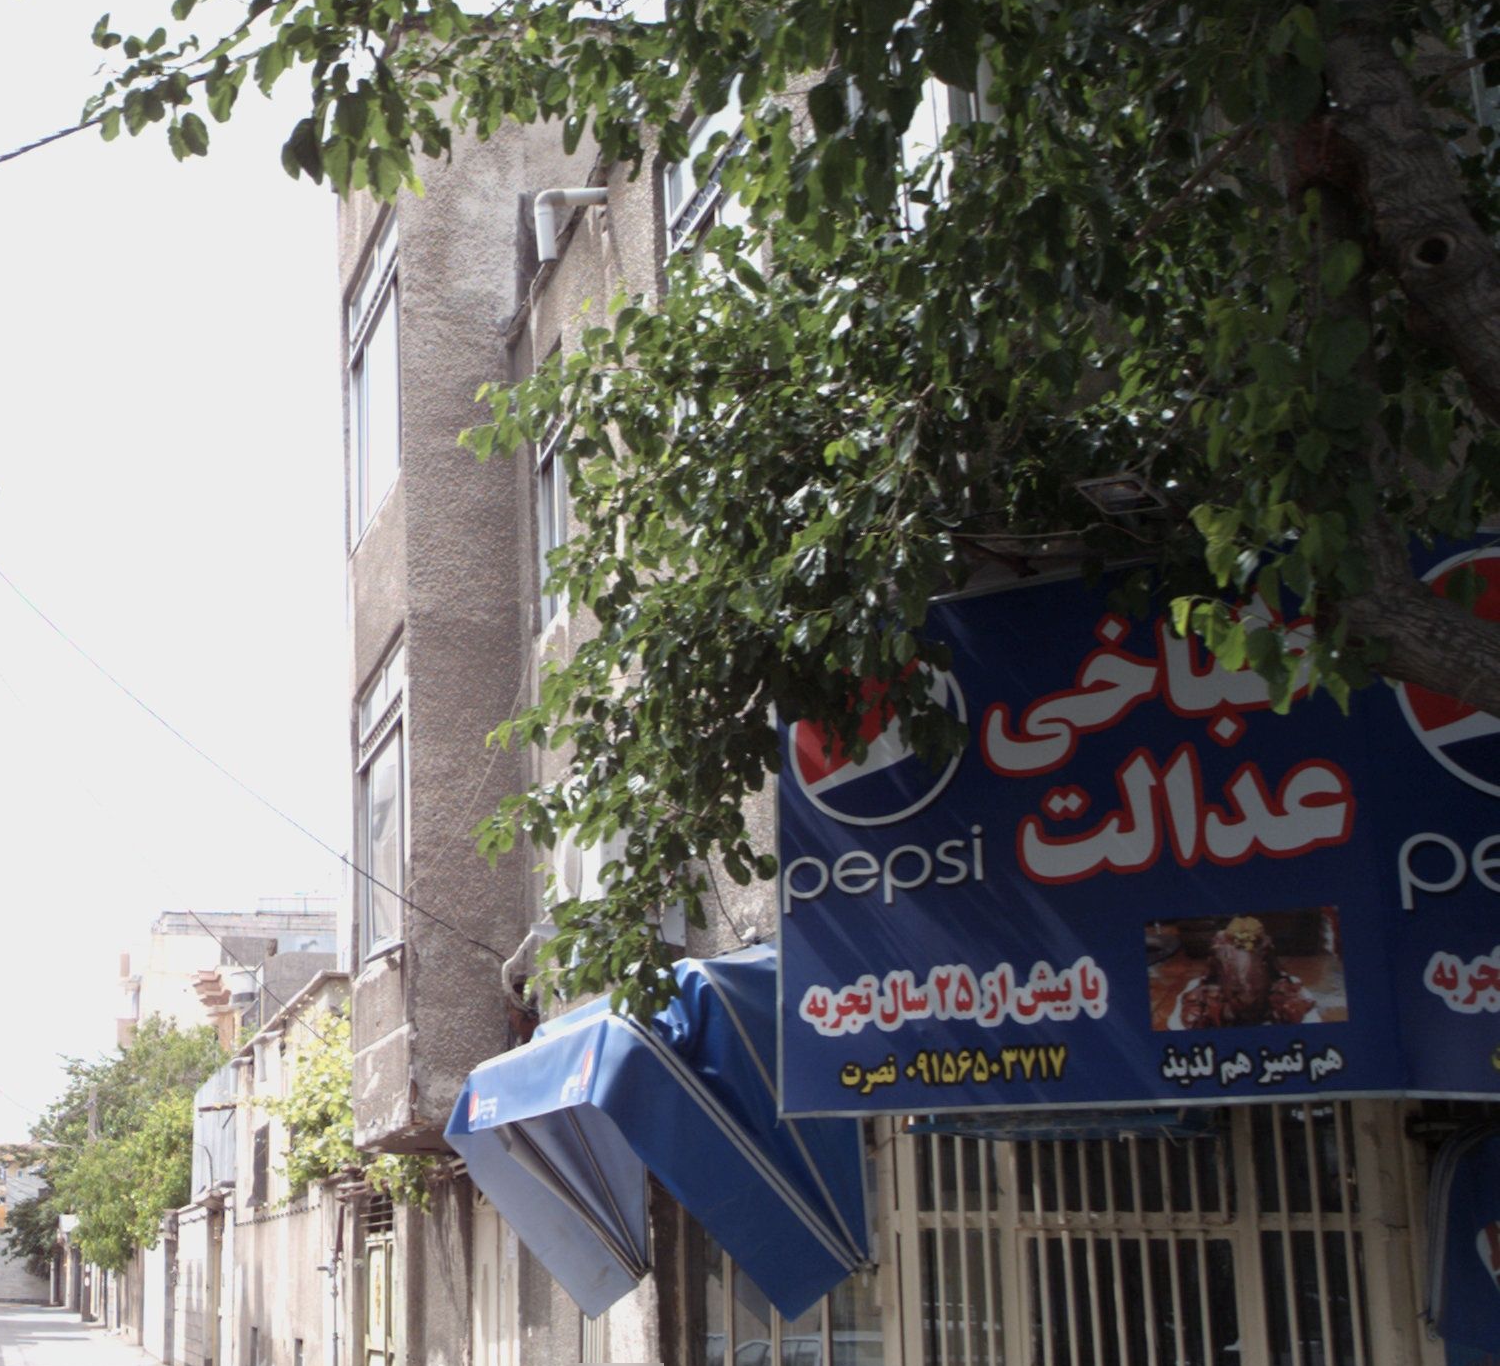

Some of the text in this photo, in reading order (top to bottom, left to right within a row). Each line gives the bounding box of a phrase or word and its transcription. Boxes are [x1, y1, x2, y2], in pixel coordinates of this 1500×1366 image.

[1017, 743, 1355, 883] عدالت
[783, 824, 984, 914] pepsi
[804, 962, 1102, 1030] با بیش از ۲۵ سال تجربه
[1430, 959, 1500, 1005] جربه
[841, 1056, 897, 1094] نصرت
[1162, 1043, 1343, 1085] هم تمیز هم لذیذ
